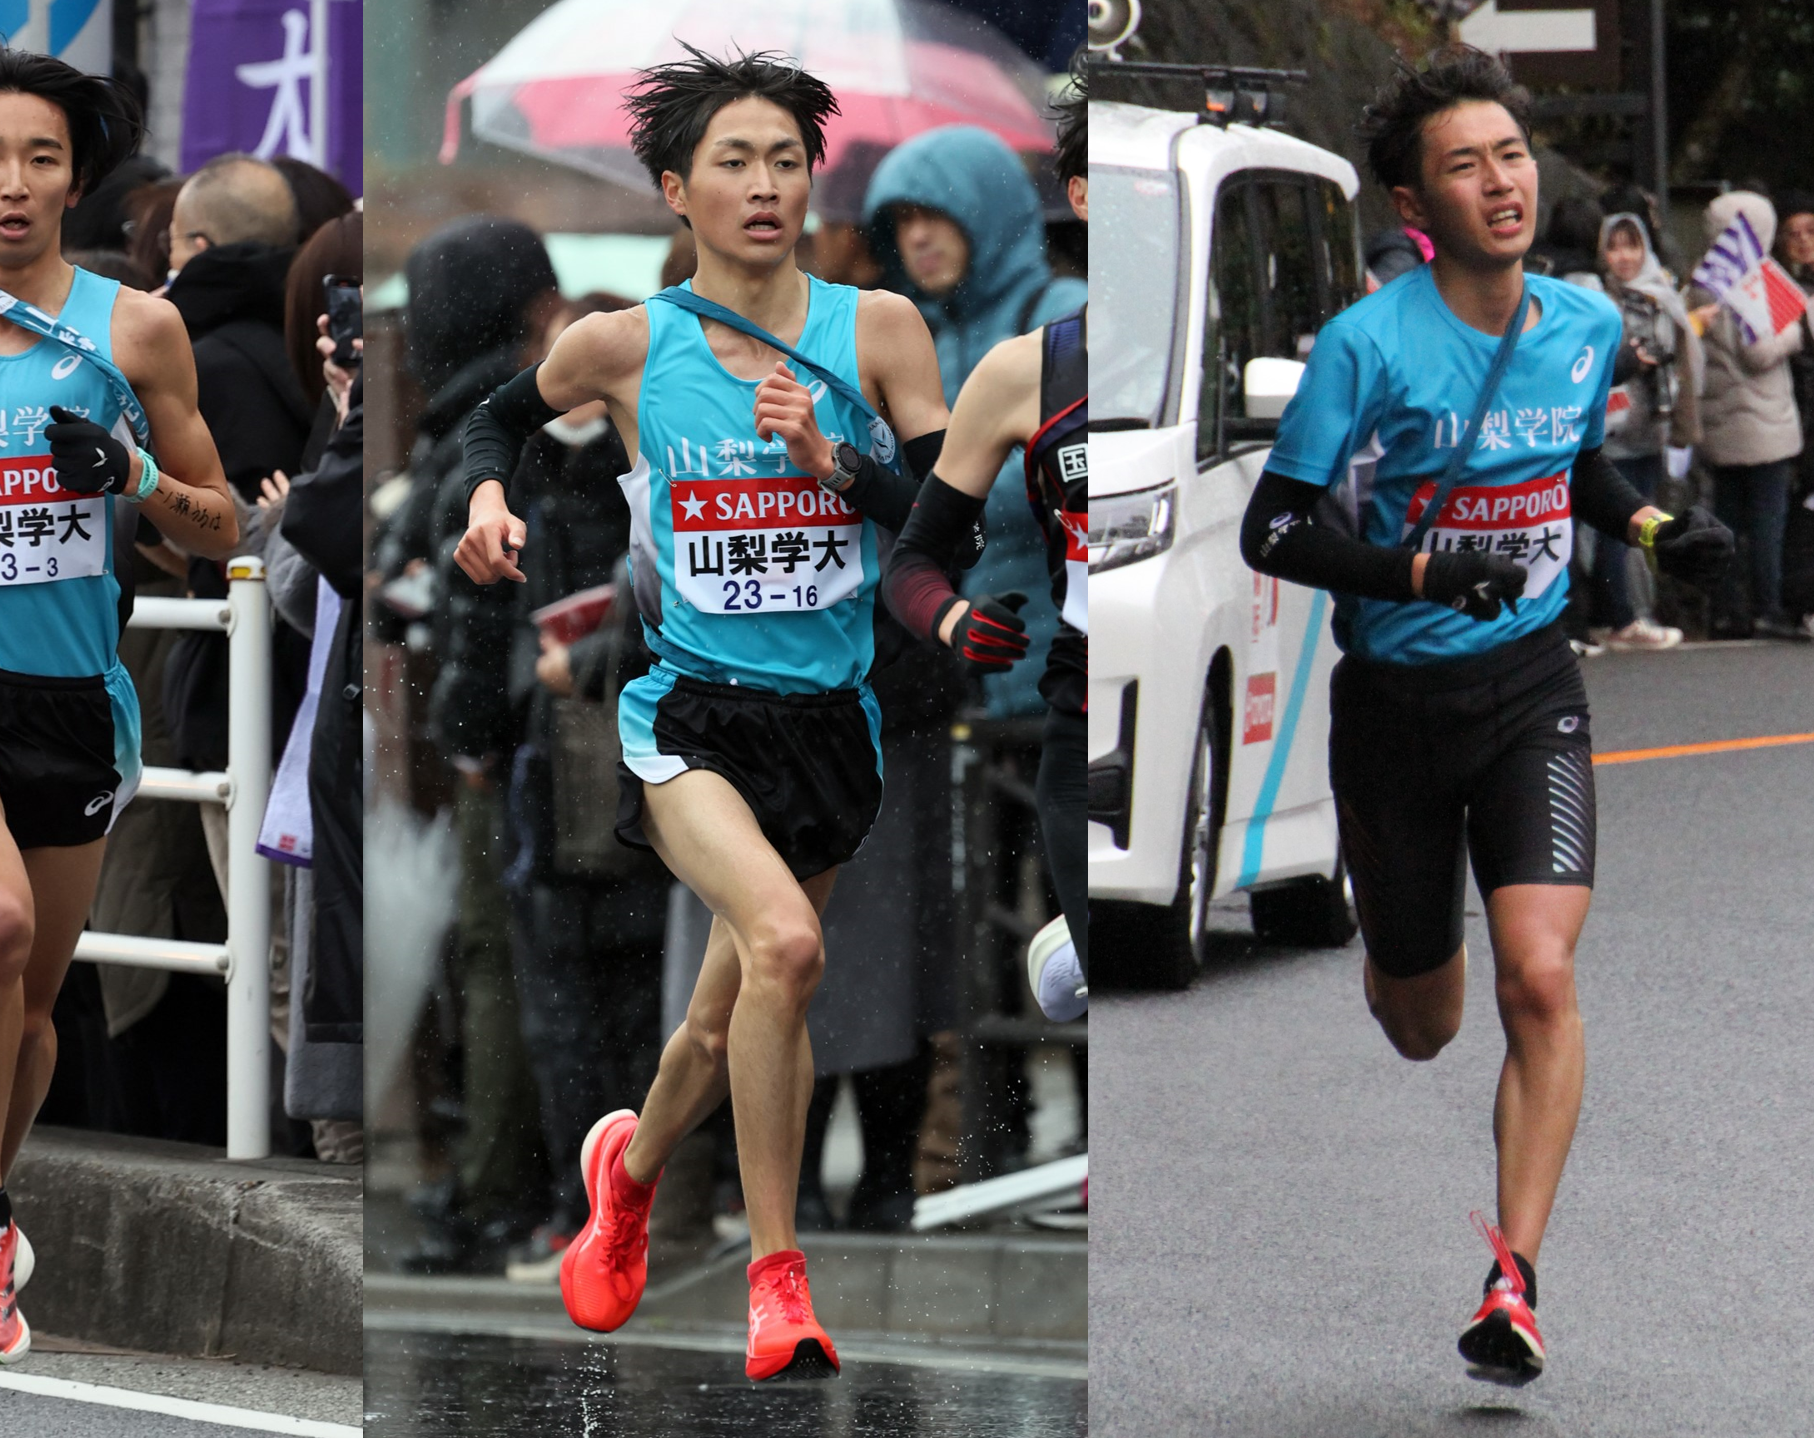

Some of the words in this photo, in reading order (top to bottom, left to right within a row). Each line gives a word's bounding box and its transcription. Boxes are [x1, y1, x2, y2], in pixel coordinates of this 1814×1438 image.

[1452, 483, 1567, 521] SAPPORO
[689, 530, 849, 577] 山梨学大
